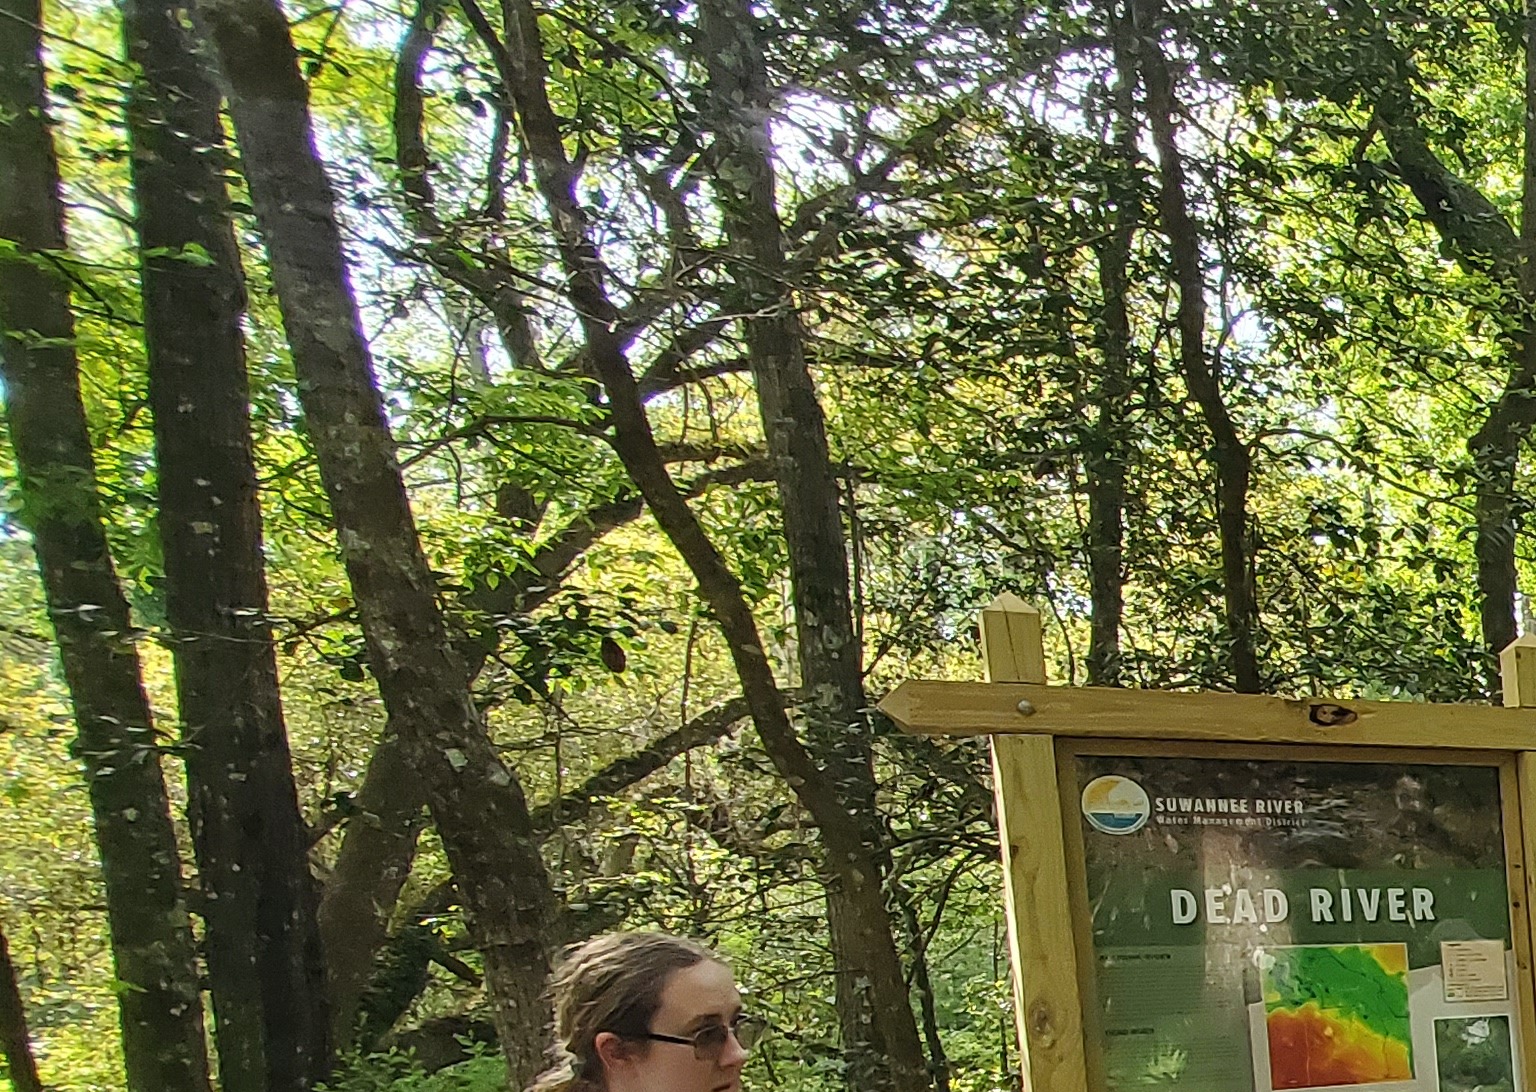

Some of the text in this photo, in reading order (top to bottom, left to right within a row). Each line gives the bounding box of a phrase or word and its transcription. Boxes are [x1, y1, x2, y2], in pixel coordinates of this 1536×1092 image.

[1155, 797, 1304, 815] SUWANNEE RIVER
[1170, 887, 1436, 924] DEAD RIVER
